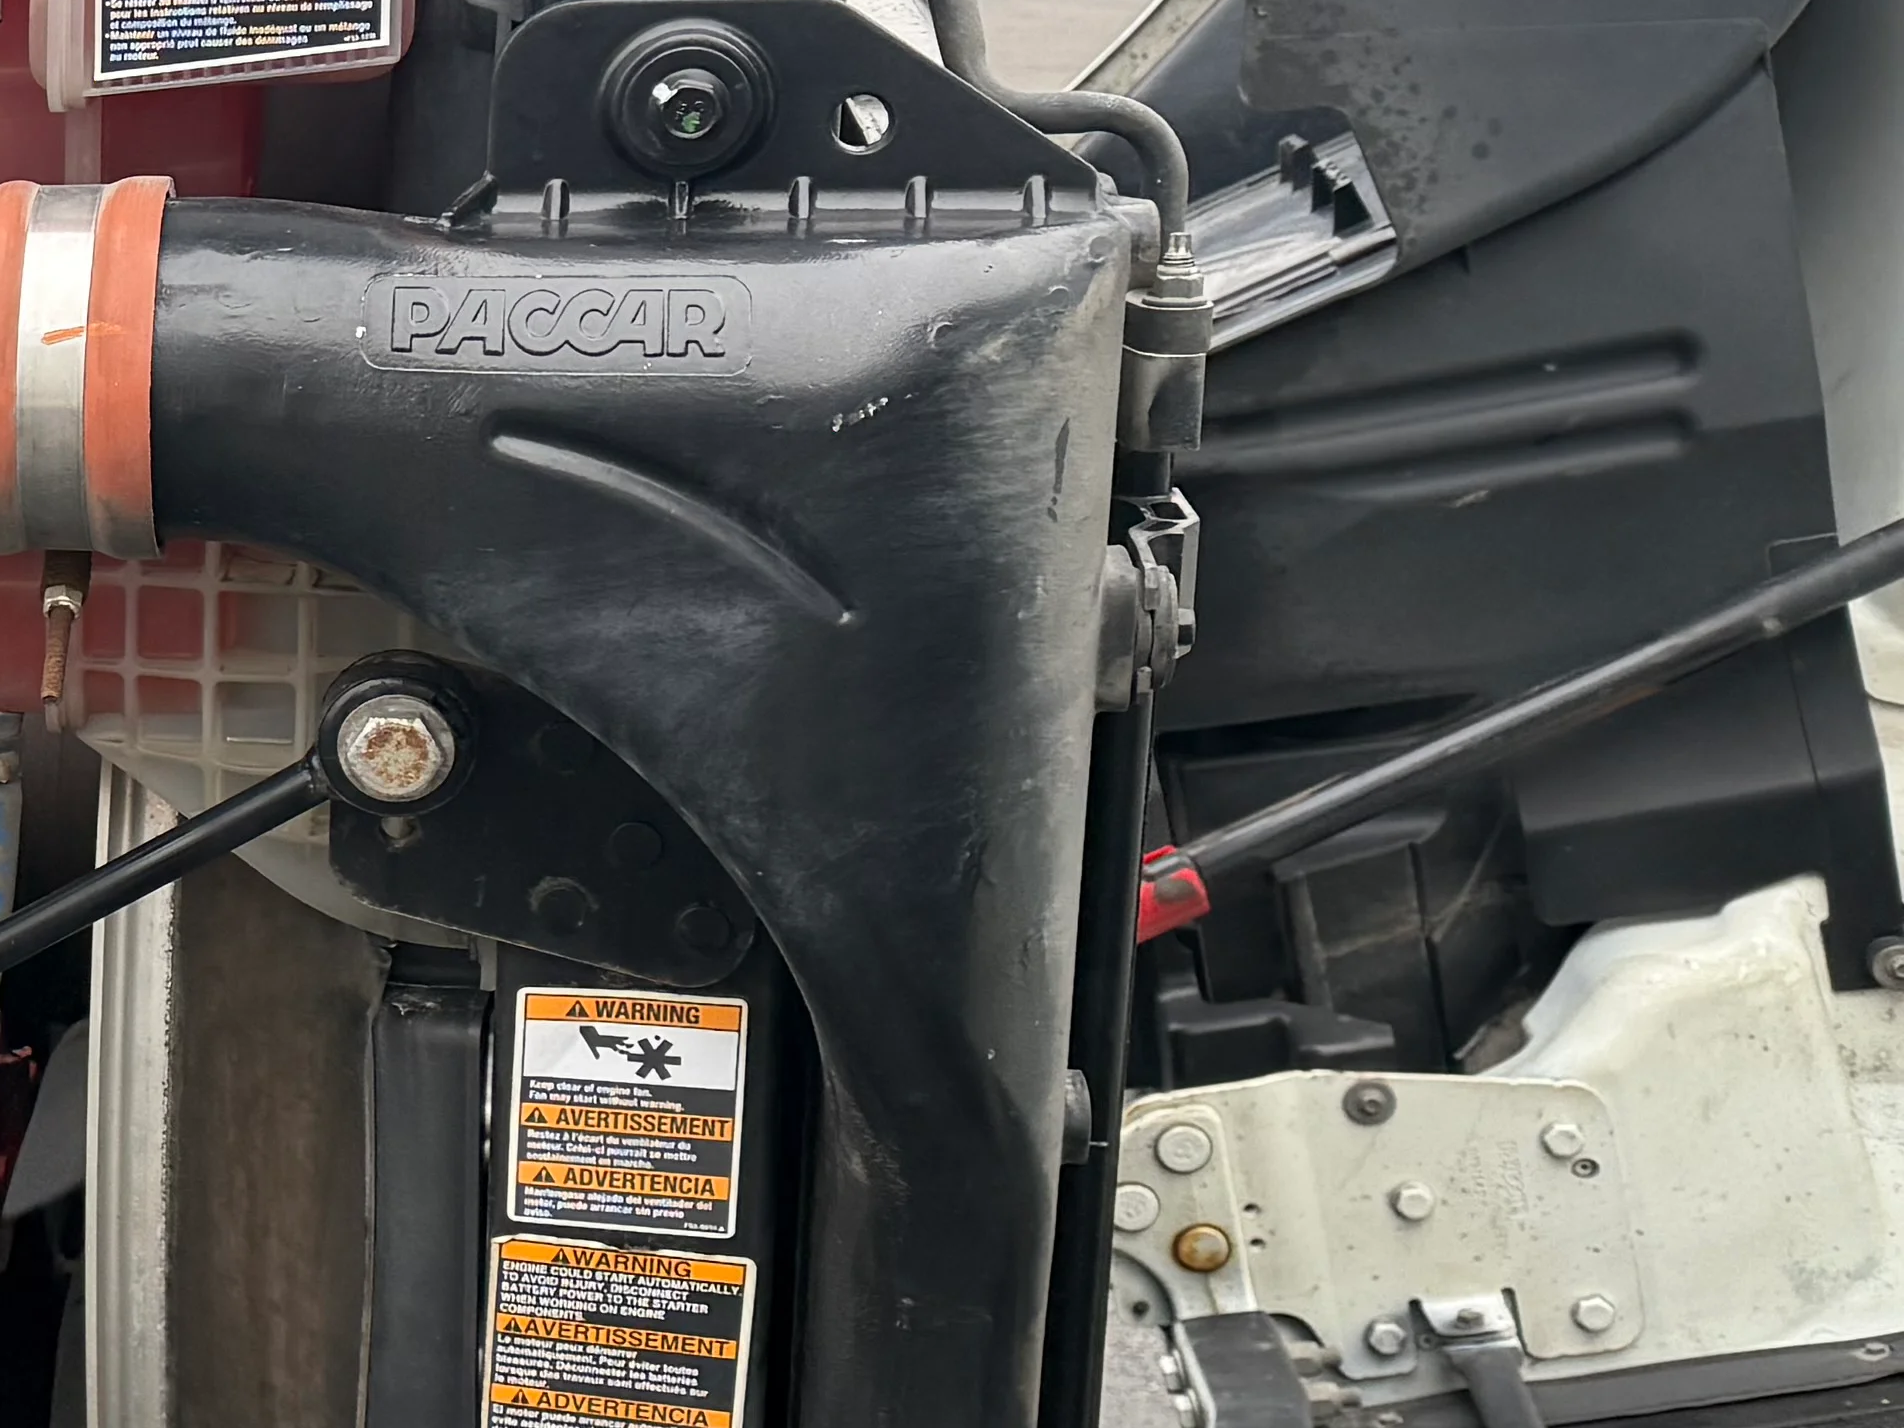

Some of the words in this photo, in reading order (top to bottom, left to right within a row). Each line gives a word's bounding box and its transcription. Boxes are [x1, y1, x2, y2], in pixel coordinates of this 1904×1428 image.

[391, 286, 727, 357] PACCAR
[595, 1000, 700, 1024] WARNING
[557, 1108, 731, 1138] AVERTISSEMENT
[564, 1167, 715, 1196] ADVERTENCIA
[503, 1261, 547, 1275] ENGINE
[550, 1266, 592, 1280] COULD
[595, 1271, 635, 1284] START
[573, 1250, 692, 1278] WARNING
[502, 1282, 556, 1297] BATTERY
[559, 1288, 604, 1302] POWER
[607, 1293, 622, 1303] TO
[626, 1295, 649, 1306] THE
[652, 1297, 708, 1312] STARTER
[503, 1271, 519, 1282] TO
[521, 1273, 558, 1286] AVOID
[610, 1283, 689, 1300] DISCONNECT
[501, 1292, 536, 1305] WHEN
[539, 1296, 596, 1312] WORKING
[600, 1302, 617, 1314] ON
[620, 1305, 665, 1319] ENGINE
[525, 1319, 730, 1356] AVERTISSEMENT
[537, 1391, 709, 1427] ADVERTENCIA
